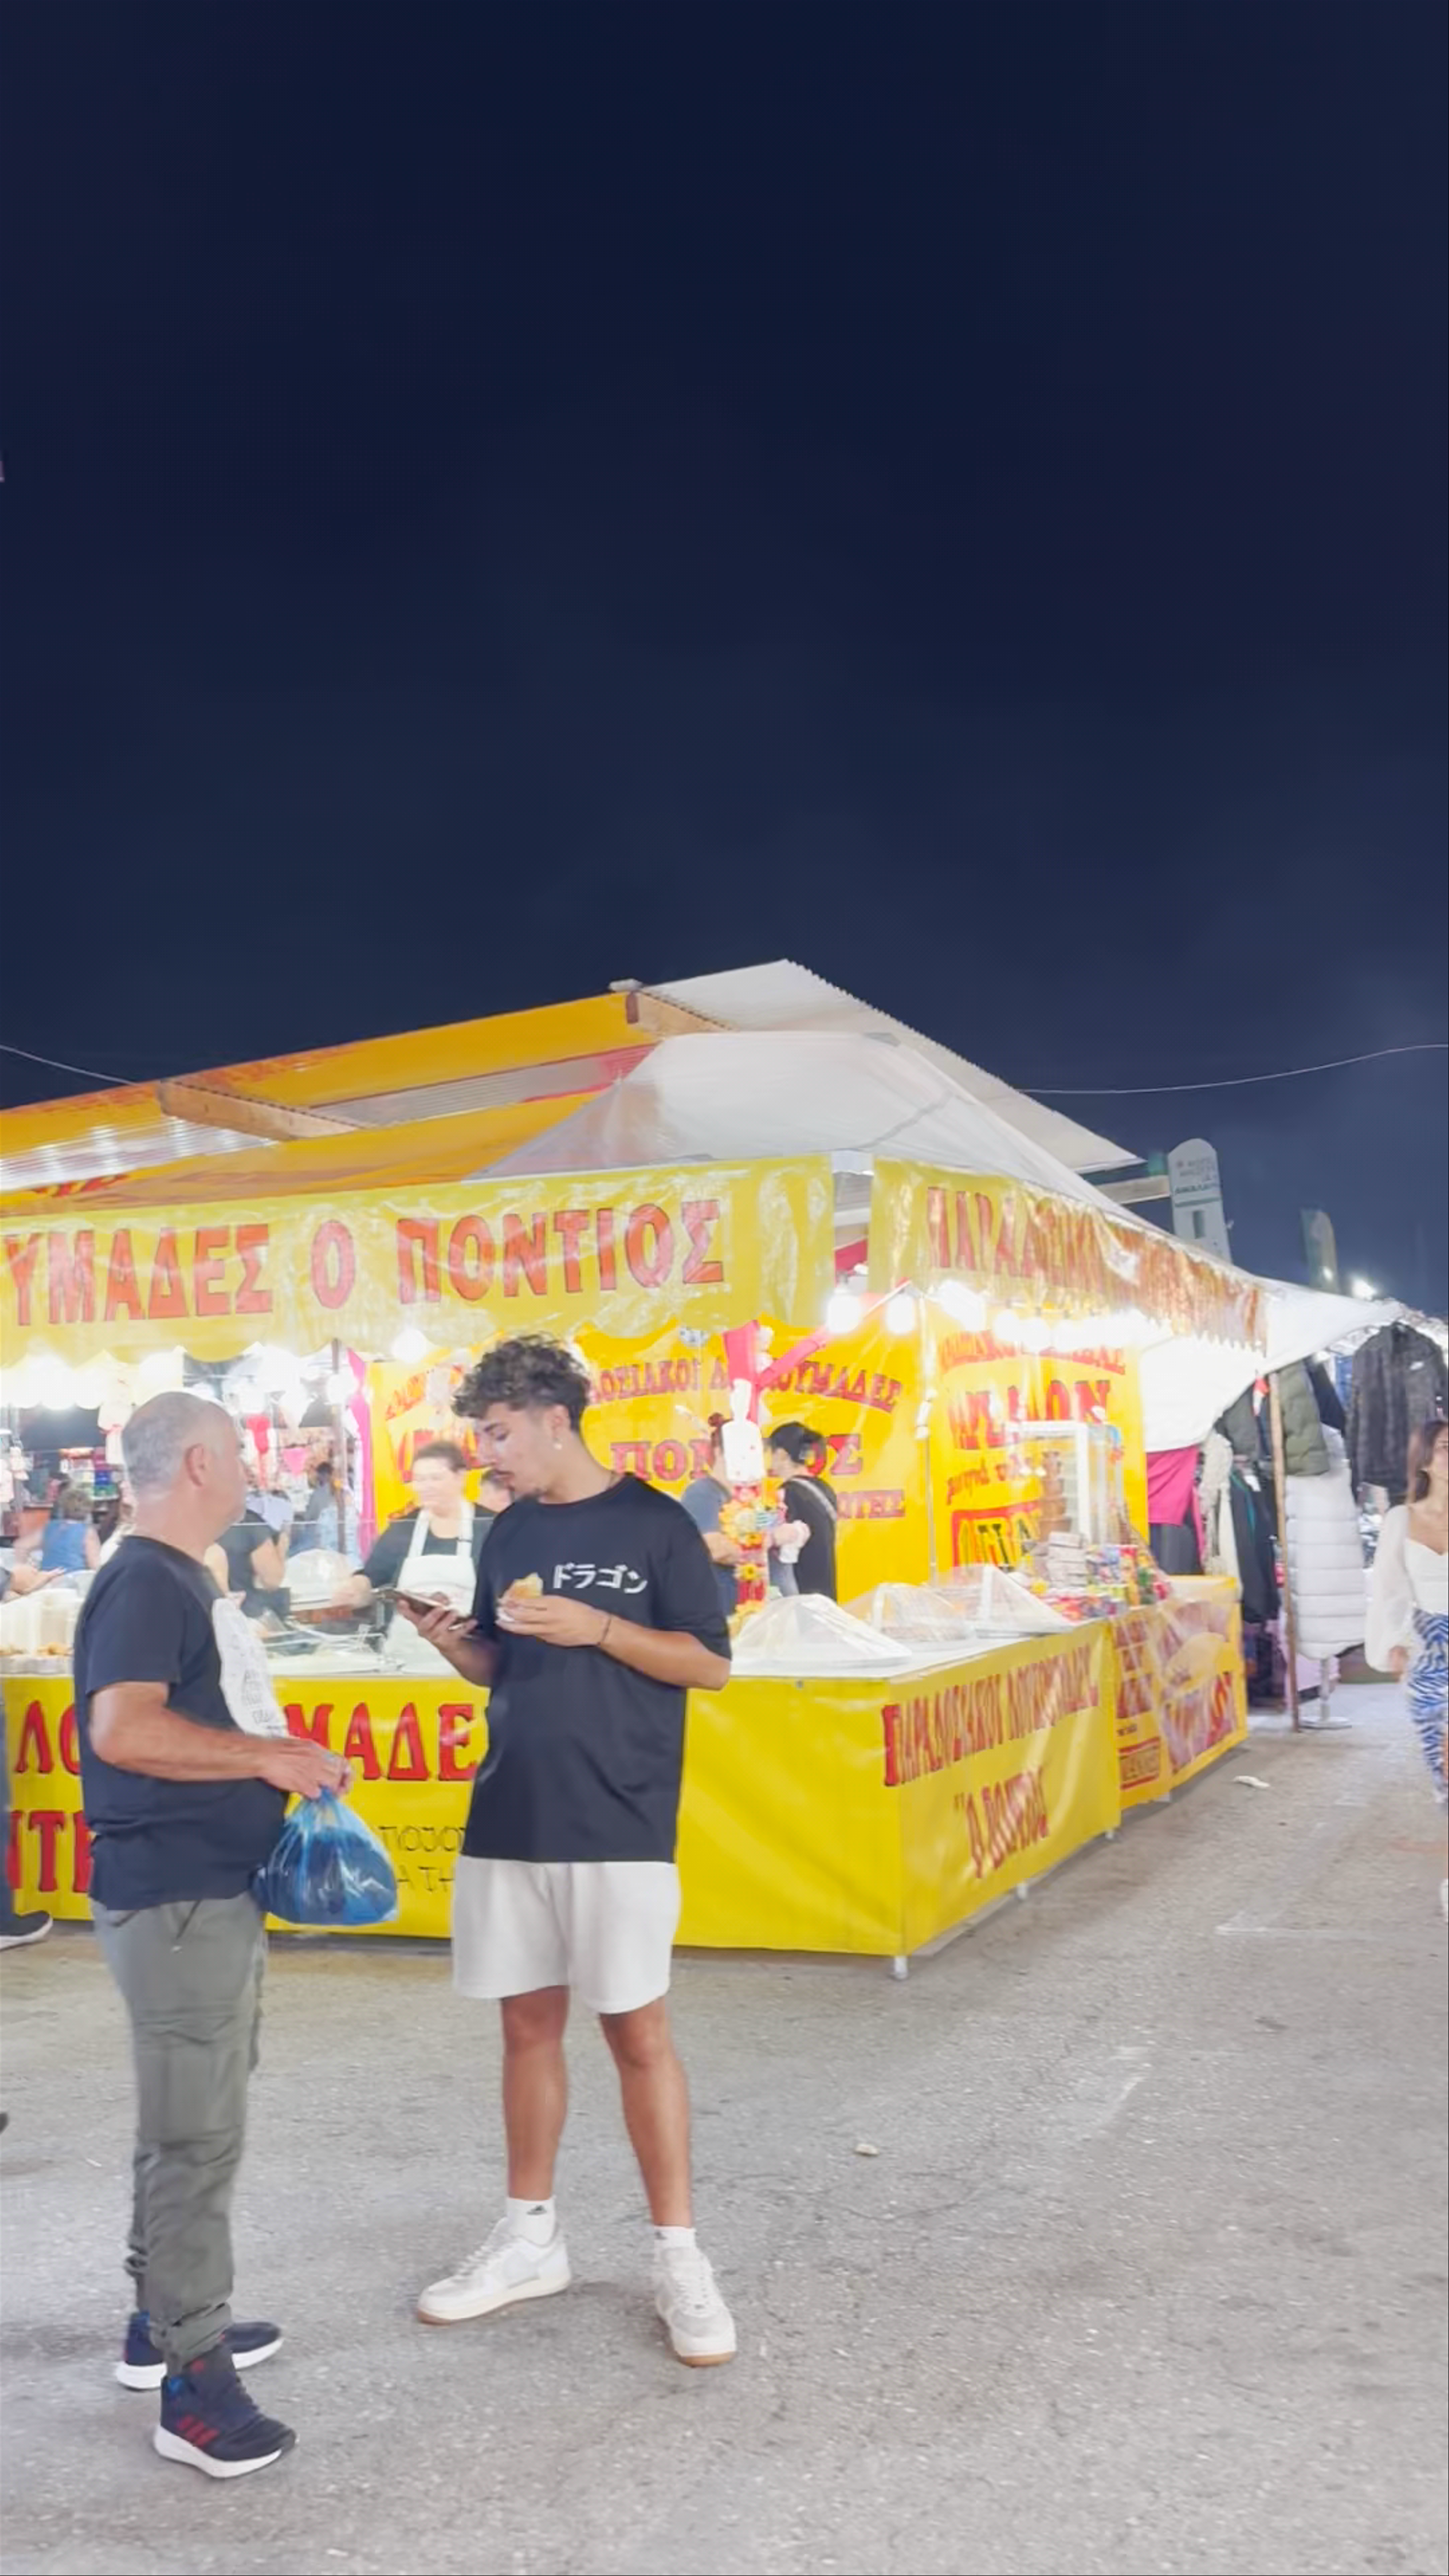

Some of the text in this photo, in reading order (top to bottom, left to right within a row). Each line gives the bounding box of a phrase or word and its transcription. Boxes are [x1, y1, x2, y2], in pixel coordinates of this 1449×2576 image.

[310, 1219, 355, 1309] Ο
[396, 1200, 724, 1304] ΠΟΝΤΙΟΣ
[553, 1562, 648, 1594] ドラゴン
